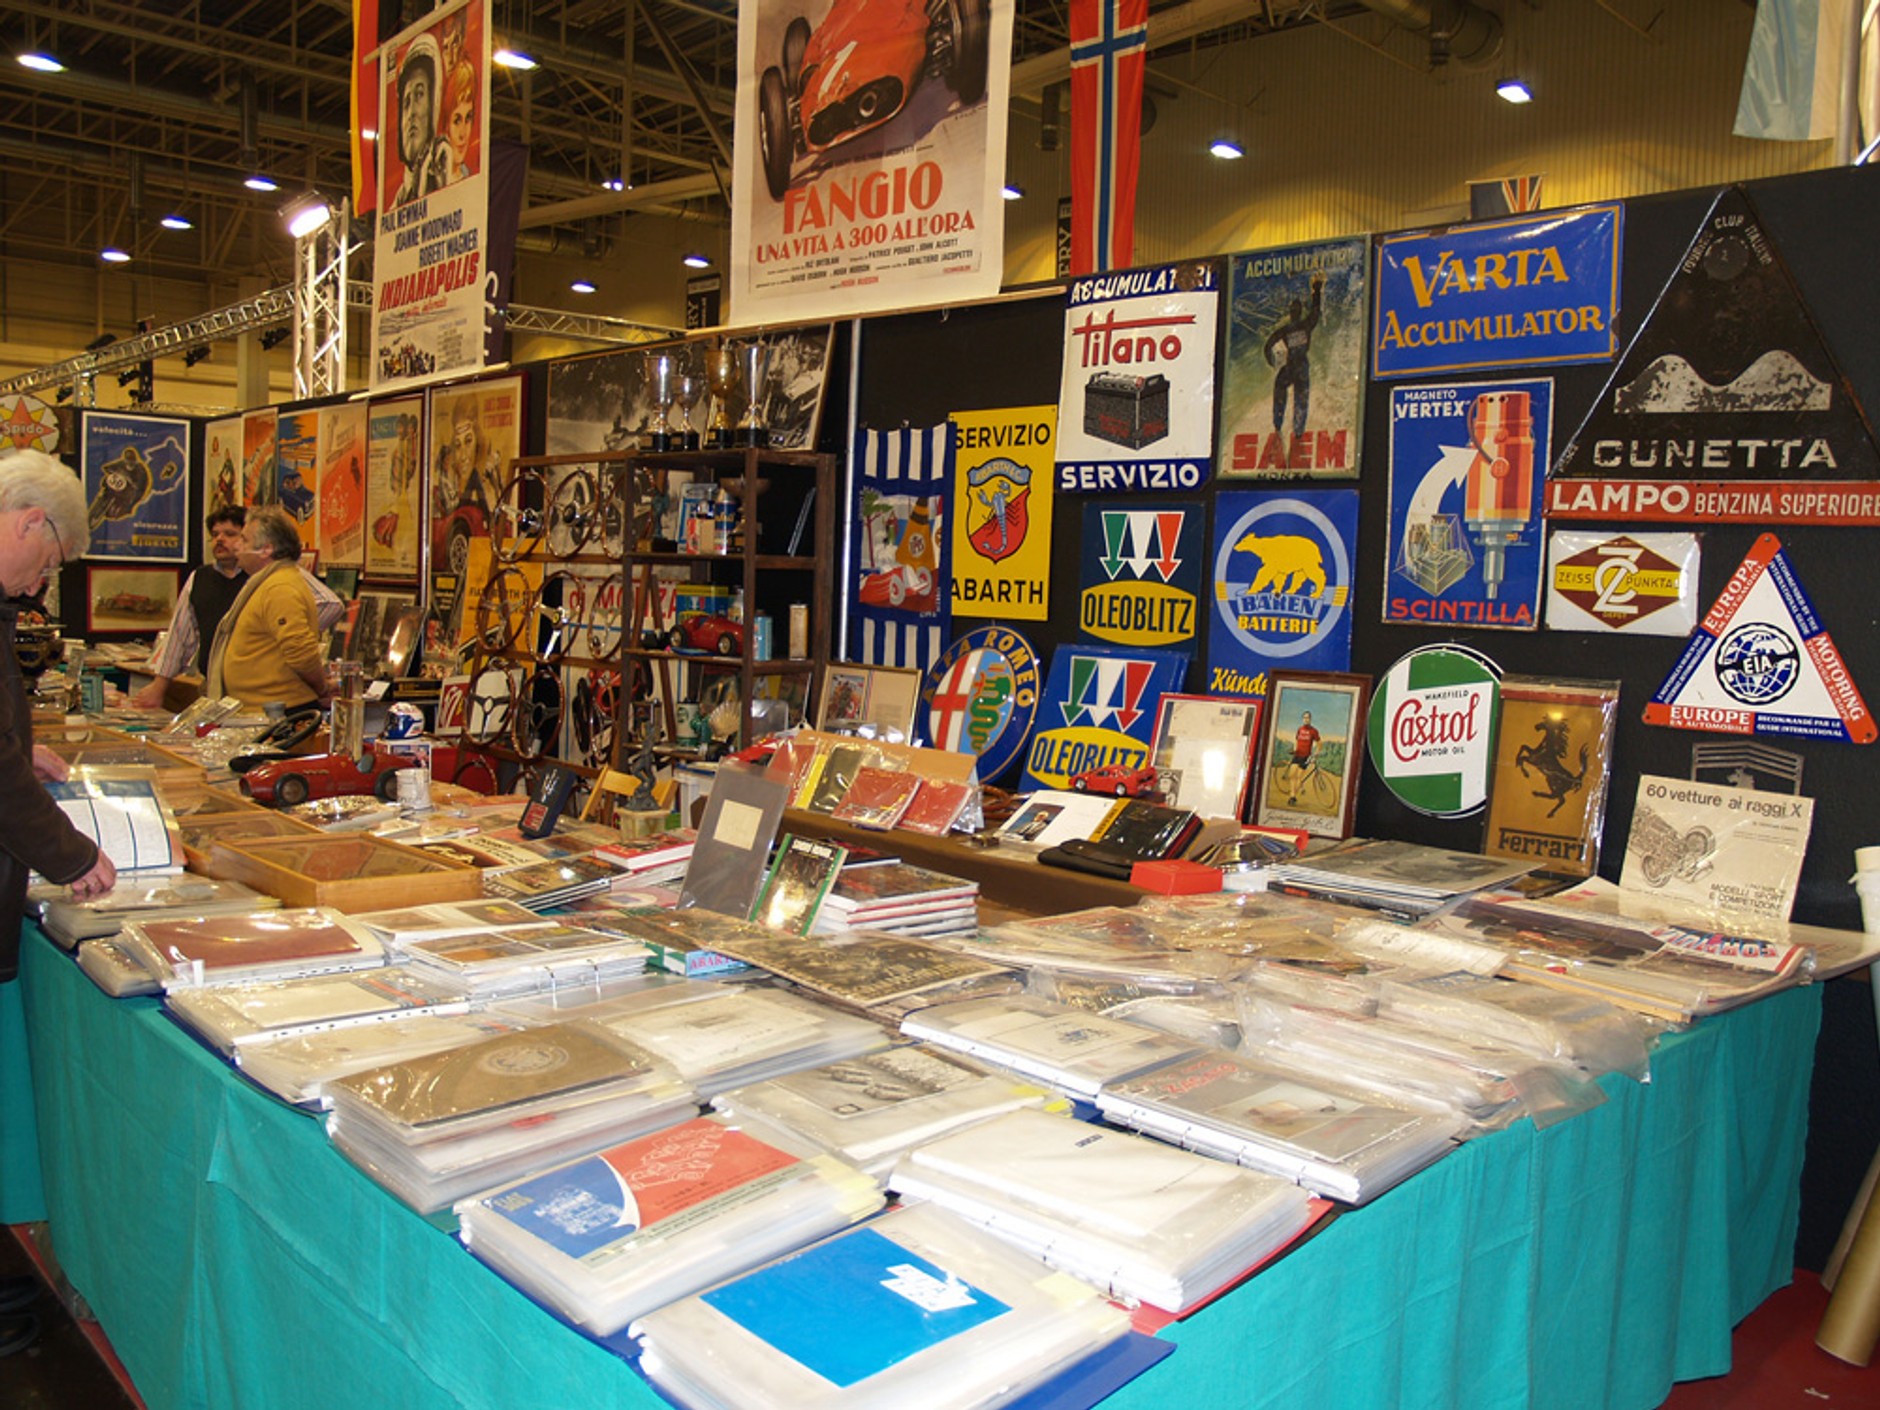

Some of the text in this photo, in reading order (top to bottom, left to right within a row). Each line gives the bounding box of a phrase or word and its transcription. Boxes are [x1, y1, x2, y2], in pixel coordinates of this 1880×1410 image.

[783, 160, 943, 234] FANGIO
[756, 209, 975, 264] UNA VITA A 300 ALL'ORA
[378, 251, 480, 311] INDIANAPOLIS
[1070, 265, 1212, 304] ACCUMULATRI
[1402, 246, 1570, 307] VARTA
[1379, 305, 1605, 350] ACCUMULATOR
[1404, 389, 1457, 401] MAGNETO
[957, 422, 1051, 450] SERVIZIO
[1232, 430, 1347, 470] SAEM
[1593, 439, 1838, 468] CUNETTA
[1061, 463, 1200, 490] SERVIZIO
[1553, 484, 1690, 514] LAMPO
[1695, 492, 1773, 515] BENZINA
[952, 577, 1044, 605] ABARTH
[1558, 571, 1592, 583] ZEISS
[1704, 559, 1758, 630] EUROPA
[1084, 592, 1193, 635] OLEOBLITZ
[1238, 615, 1319, 635] BATTERIE
[1390, 598, 1533, 625] SCINTILLA
[923, 629, 1034, 708] ALFA ROMEO
[1743, 655, 1773, 676] EIA
[1813, 636, 1865, 722] MOTORING
[1424, 689, 1470, 701] WAKEFIELD
[1391, 692, 1481, 762] Castrol
[1671, 706, 1750, 726] EUROPE
[1686, 720, 1750, 732] AUTOMOBILE
[1781, 724, 1844, 737] INTERNATIONAL
[1421, 746, 1466, 758] MOTOR OIL
[1646, 784, 1803, 818] 60 vetture ai raggi X
[1498, 828, 1586, 863] Ferrari
